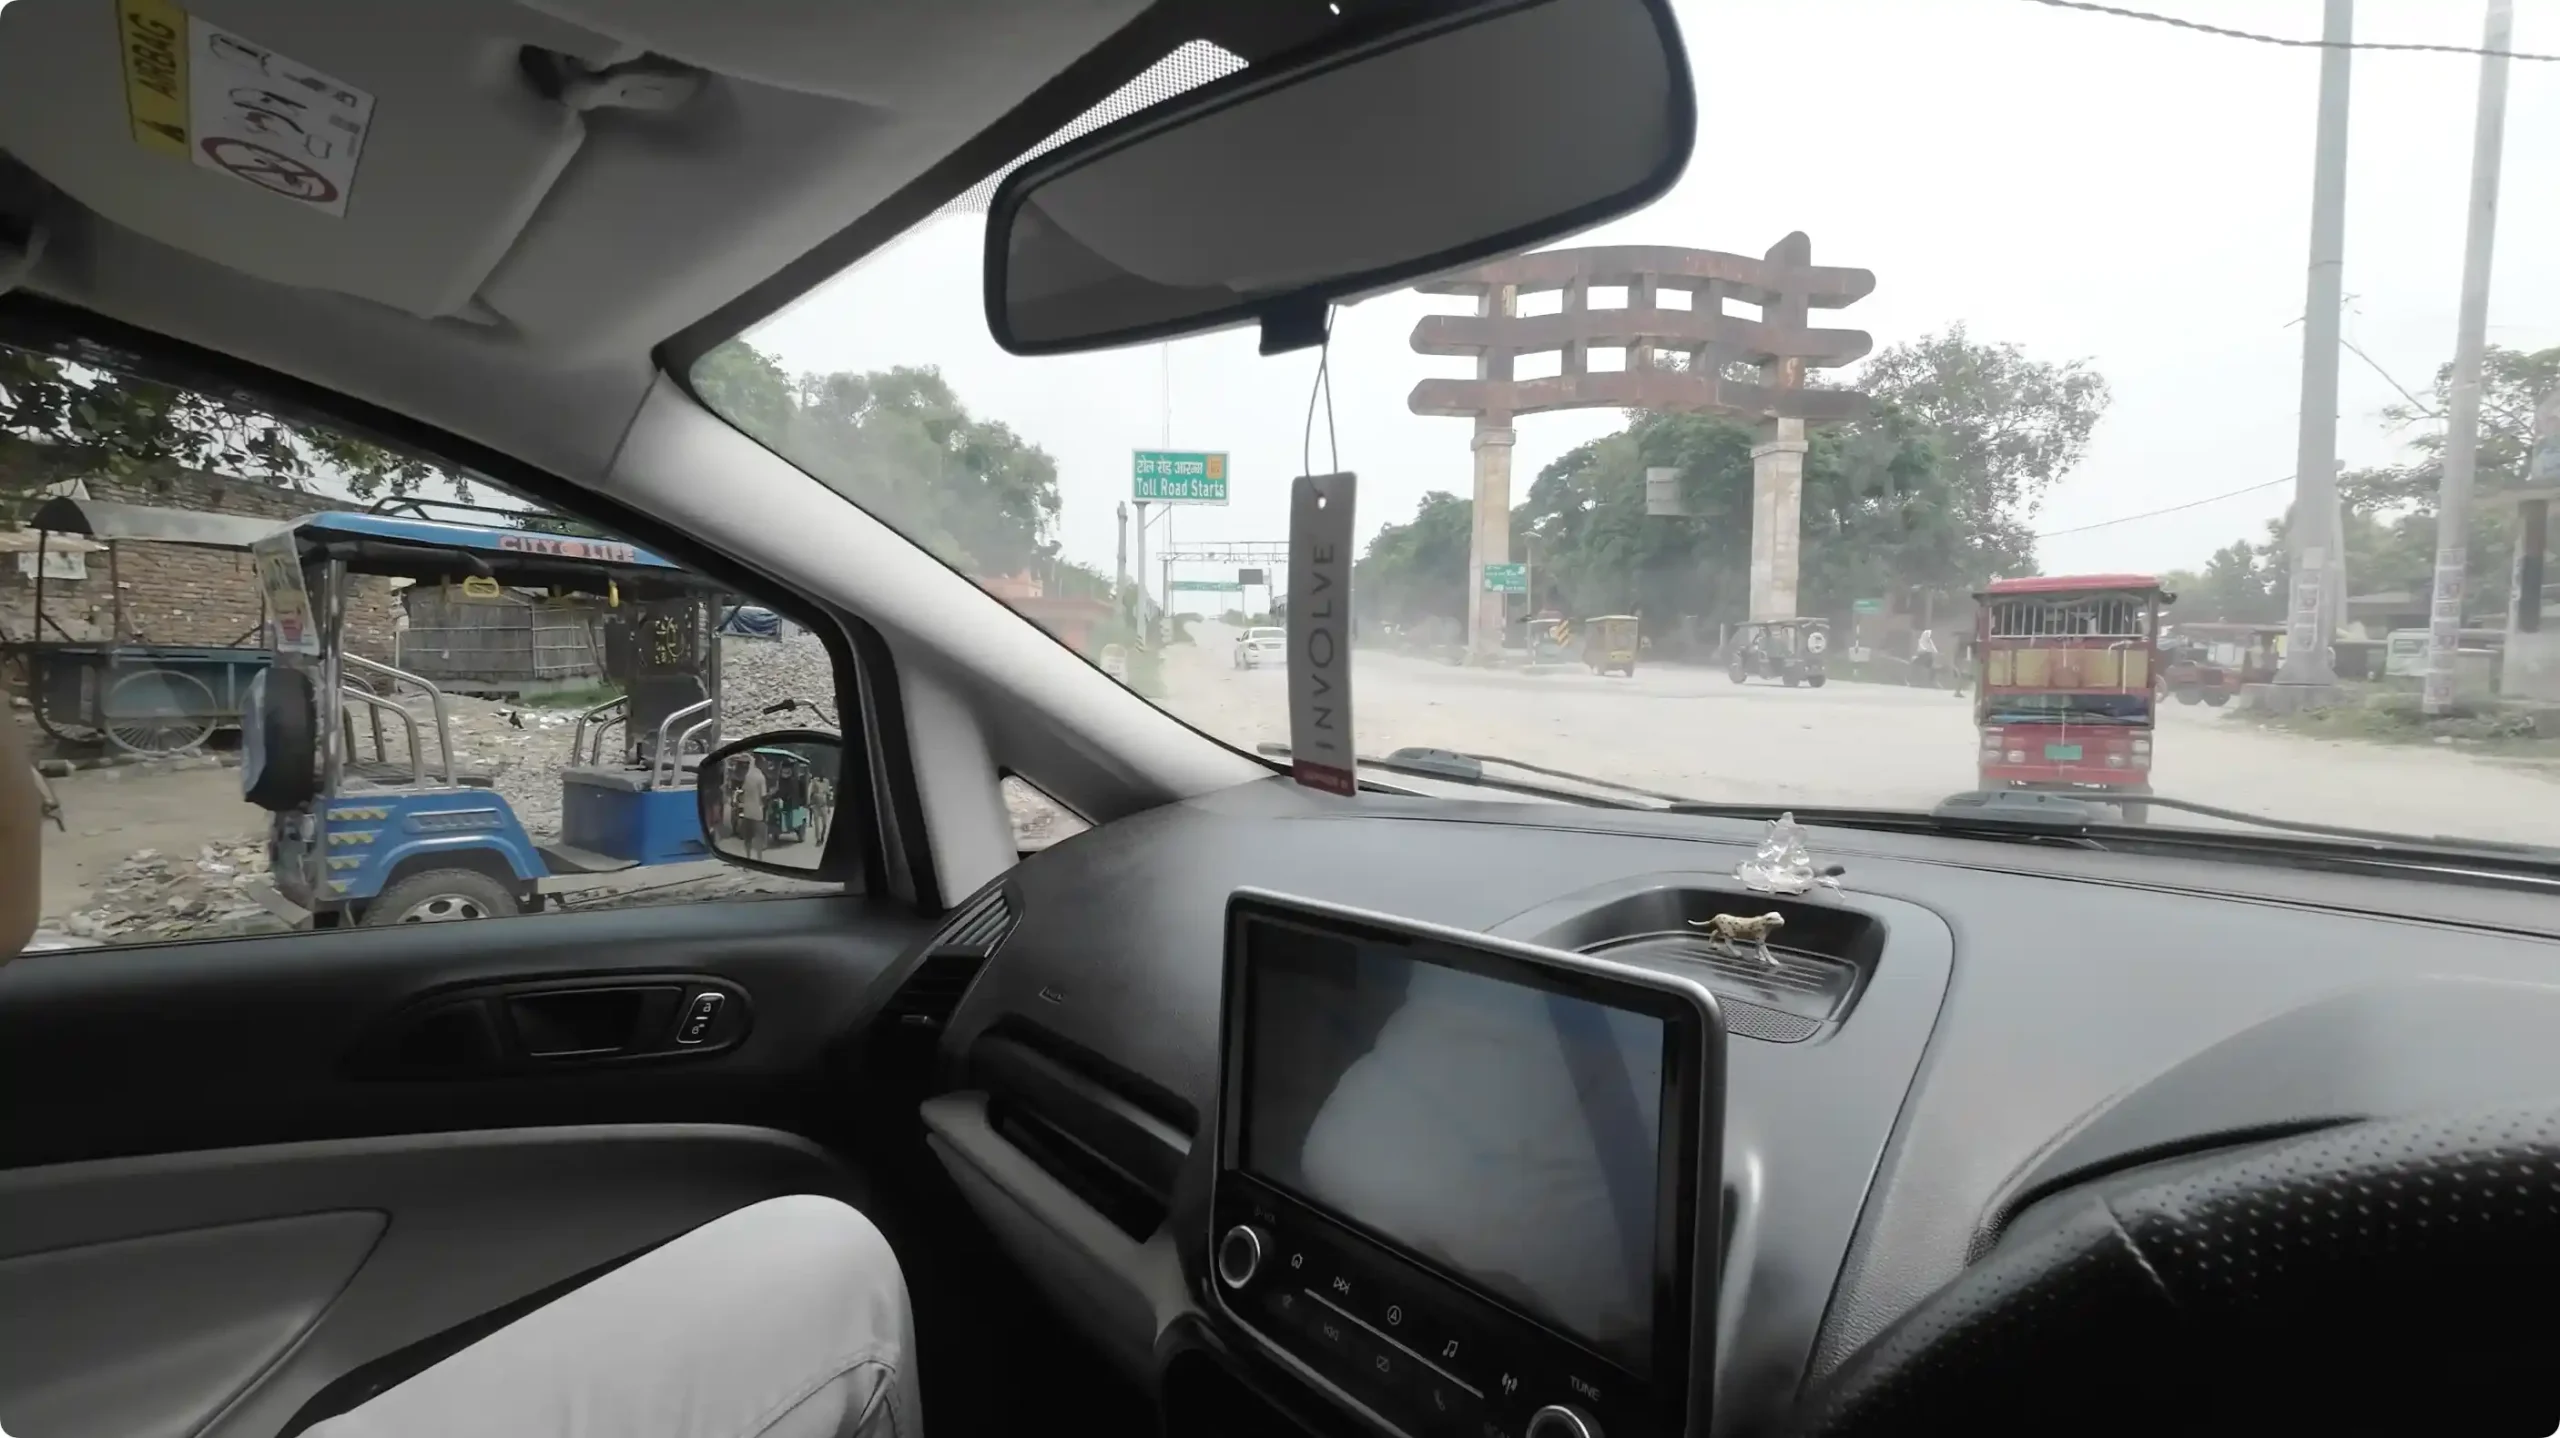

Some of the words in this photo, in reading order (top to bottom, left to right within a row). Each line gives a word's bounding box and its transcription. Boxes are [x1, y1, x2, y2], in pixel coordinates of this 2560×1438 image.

[128, 12, 177, 101] AIRBAG
[1136, 454, 1154, 474] टोल
[1136, 477, 1157, 496] Toll
[1160, 478, 1188, 496] Road
[1191, 478, 1225, 498] Starts
[500, 535, 558, 554] CITY
[586, 543, 635, 563] LIFE
[1308, 543, 1335, 751] INVOLVE
[1568, 1374, 1602, 1403] TUNE
